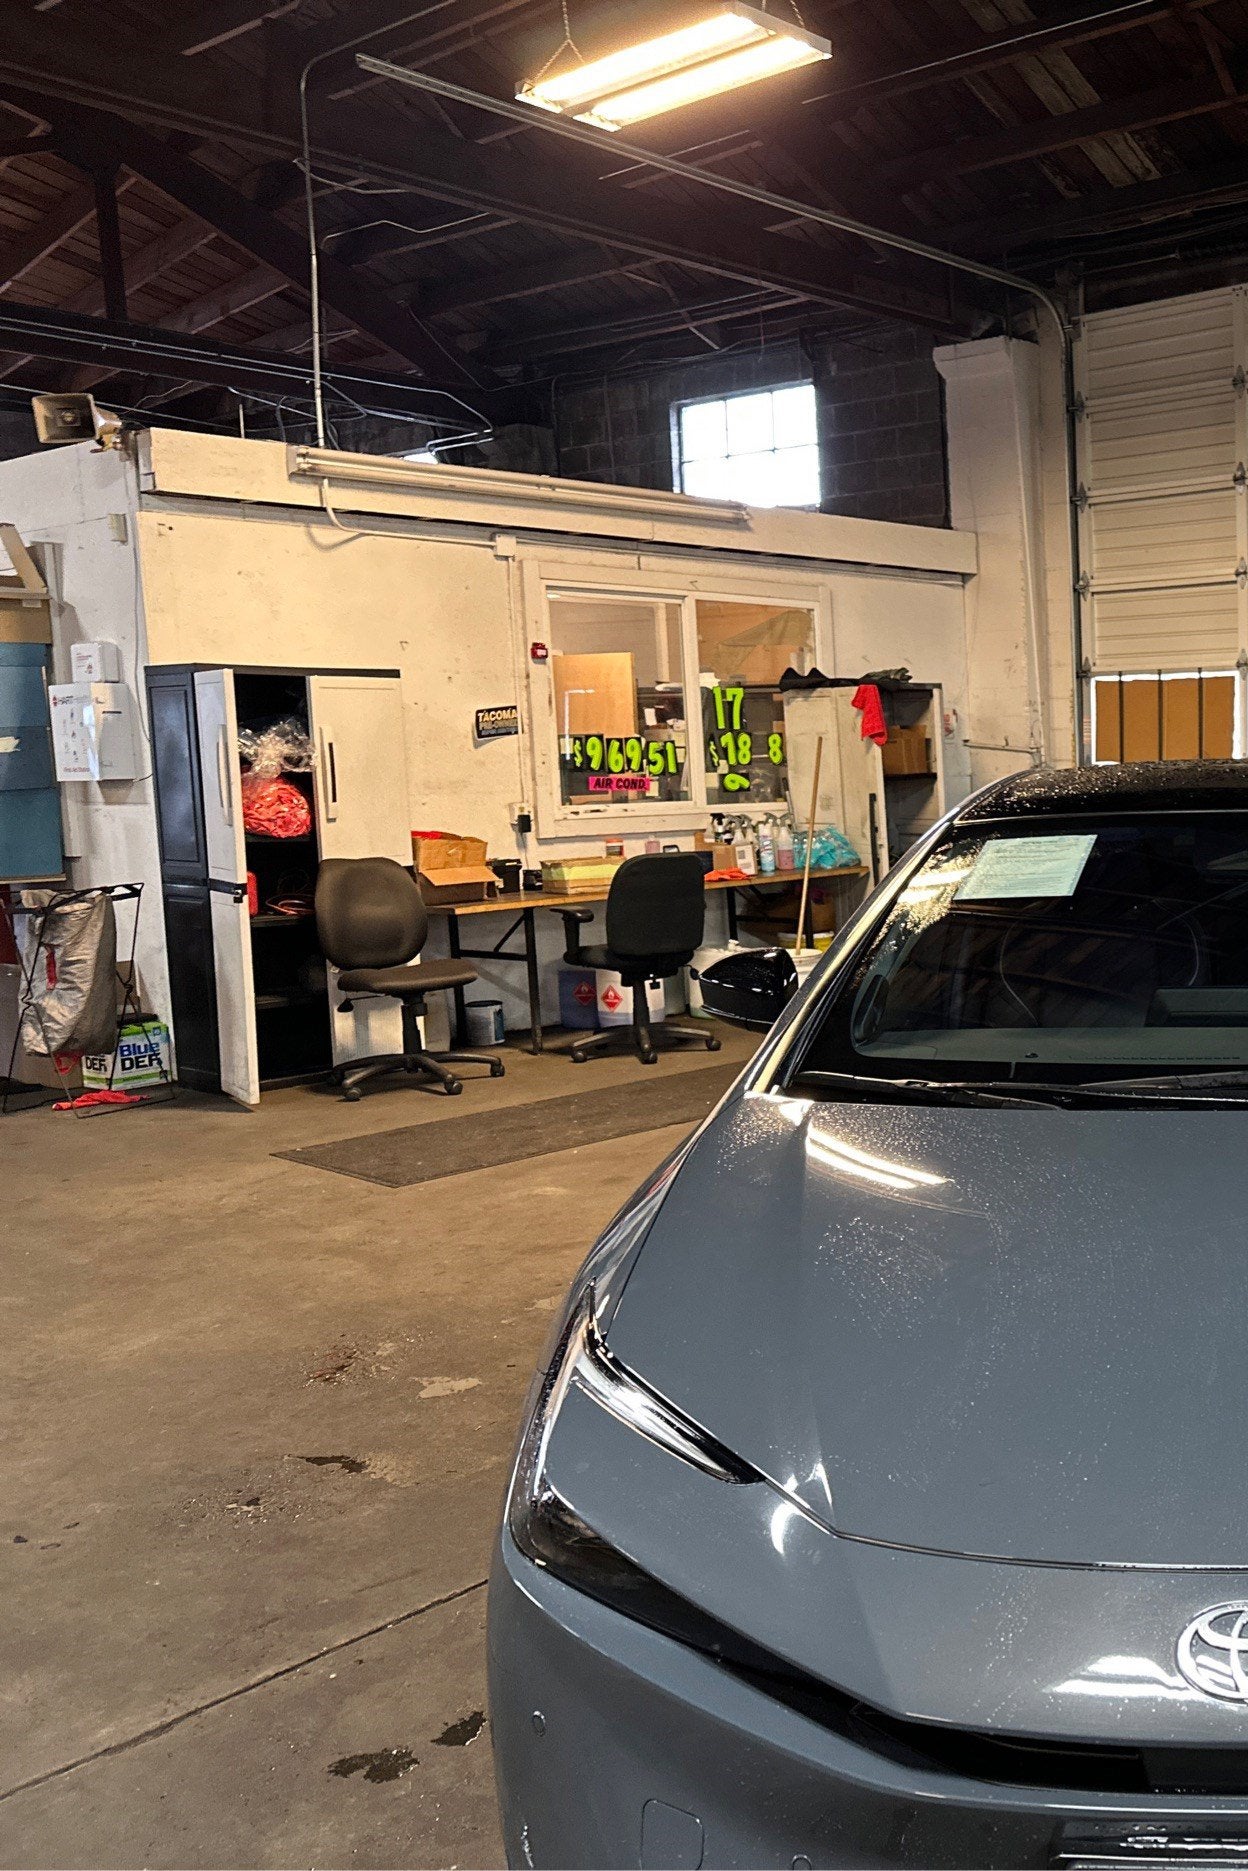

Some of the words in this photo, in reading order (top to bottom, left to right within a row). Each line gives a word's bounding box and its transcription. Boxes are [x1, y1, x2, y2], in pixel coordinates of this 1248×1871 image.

[478, 708, 517, 722] TACOMA
[713, 686, 744, 729] 17
[768, 733, 783, 765] 8
[594, 778, 612, 789] AIR
[120, 1042, 160, 1057] Blue
[121, 1053, 161, 1071] DEF
